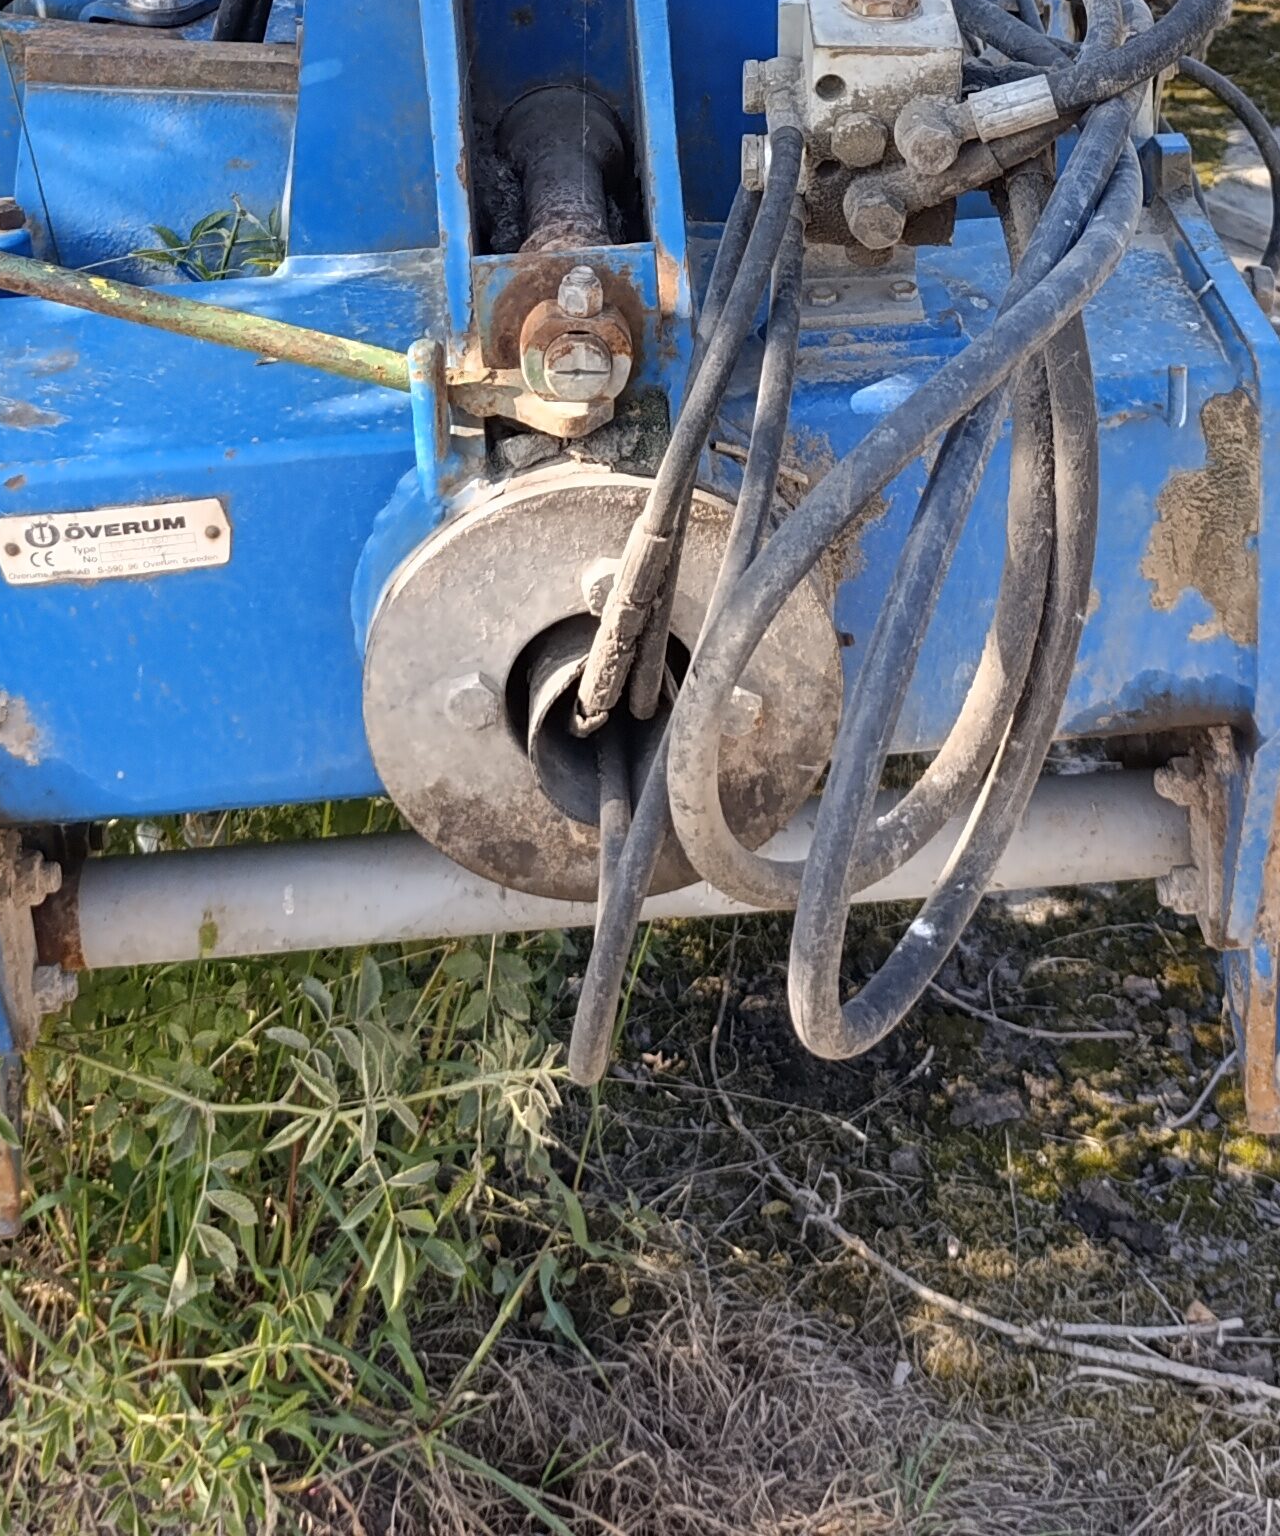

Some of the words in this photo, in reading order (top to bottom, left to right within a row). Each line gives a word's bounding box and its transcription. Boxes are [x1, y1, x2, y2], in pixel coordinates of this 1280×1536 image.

[64, 515, 187, 540] ÖVERUM
[72, 545, 96, 555] Type
[82, 555, 98, 563] No
